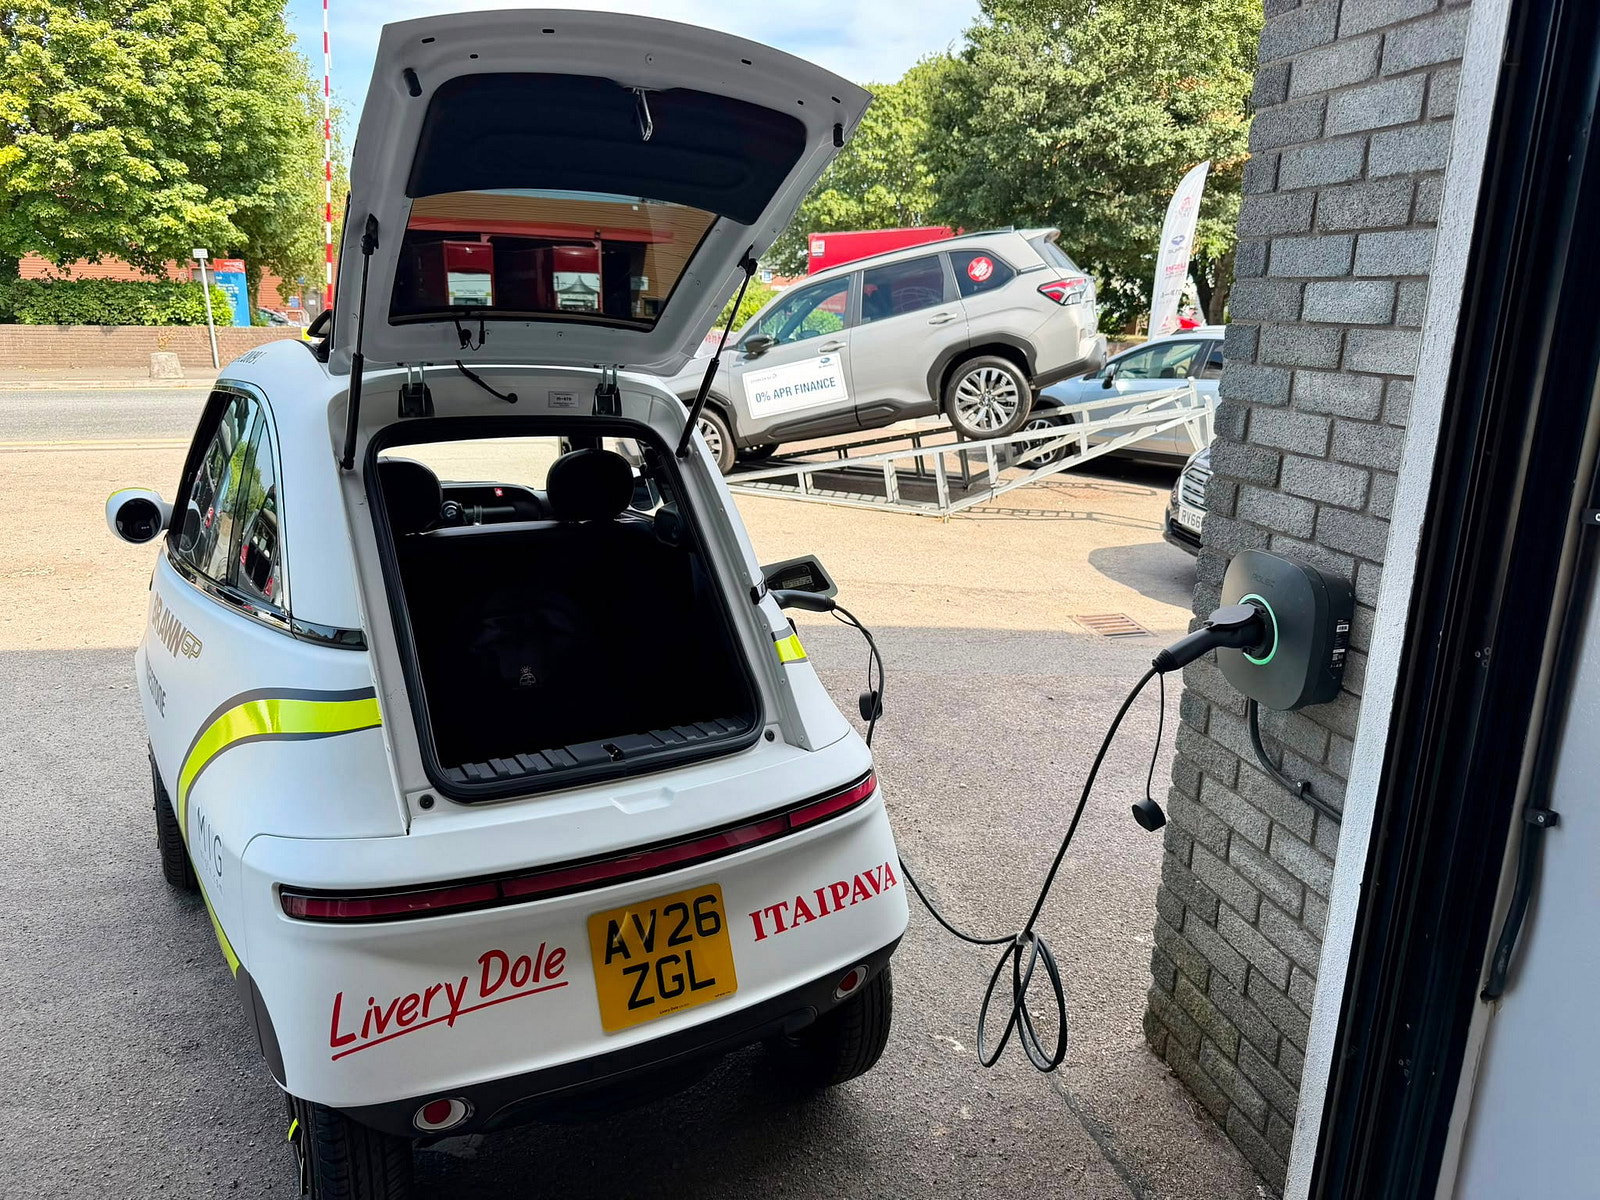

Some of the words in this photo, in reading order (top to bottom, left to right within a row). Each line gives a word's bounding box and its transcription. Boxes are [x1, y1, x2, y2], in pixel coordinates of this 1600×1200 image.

[755, 390, 771, 403] 0%
[773, 386, 793, 400] APR
[794, 376, 836, 395] FINANCE
[604, 894, 721, 965] AV26
[748, 861, 898, 942] ITAIPAVA
[330, 976, 469, 1048] Livery
[478, 941, 567, 998] Dole
[622, 950, 716, 1011] ZGL
